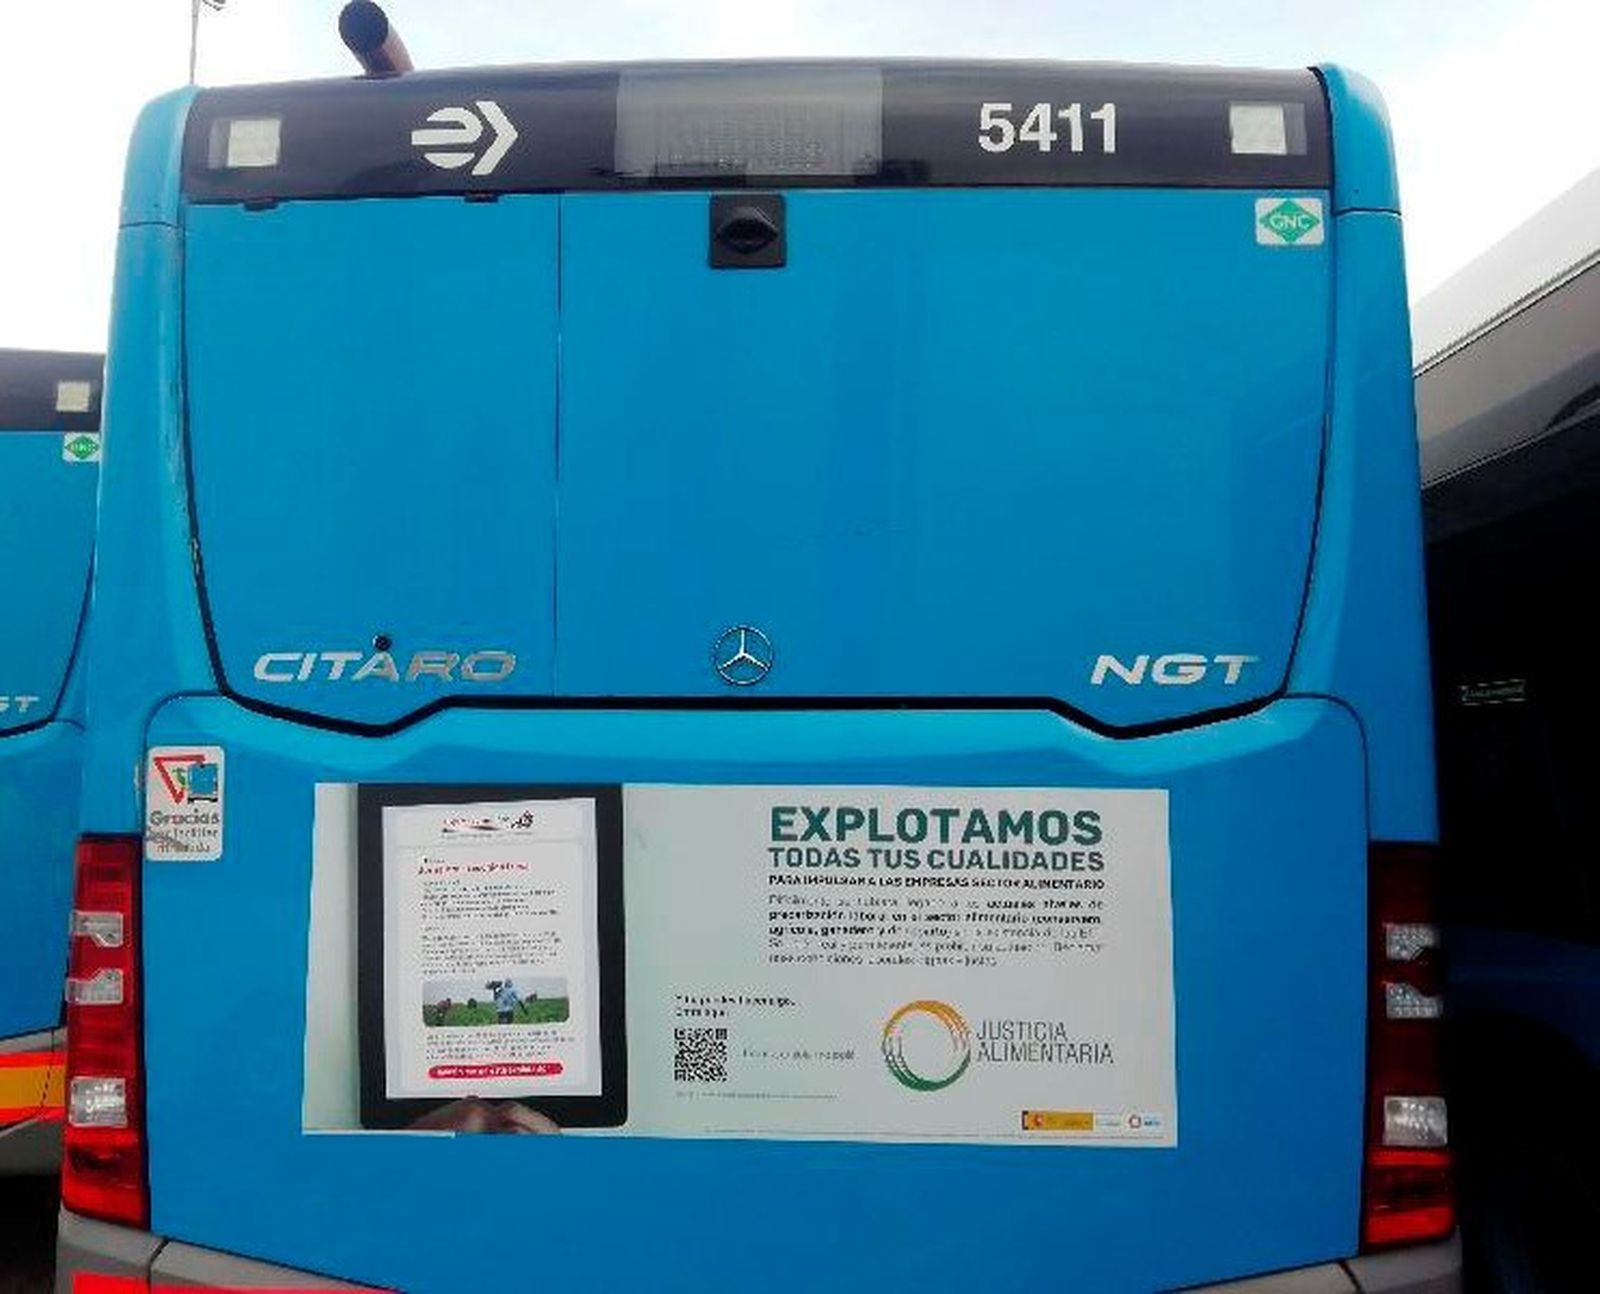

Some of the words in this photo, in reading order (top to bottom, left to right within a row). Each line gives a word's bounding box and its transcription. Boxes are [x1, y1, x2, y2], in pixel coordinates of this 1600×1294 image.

[978, 102, 1116, 153] 5411
[1268, 214, 1313, 231] GNC
[253, 650, 517, 683] CITARO
[1090, 653, 1260, 685] NGT
[150, 807, 220, 826] Gracias
[770, 806, 1104, 846] EXPLOTAMOS
[767, 847, 861, 869] TODAS
[867, 848, 922, 870] TUS
[927, 849, 1106, 873] CUALIDADES
[768, 875, 801, 886] PARA
[879, 877, 902, 888] LAS
[905, 877, 969, 888] EMPRESAS
[1023, 878, 1105, 890] ALIMENTARIO
[976, 1020, 1068, 1042] JUSTICIA
[976, 1041, 1115, 1065] ALIMENTARIA
